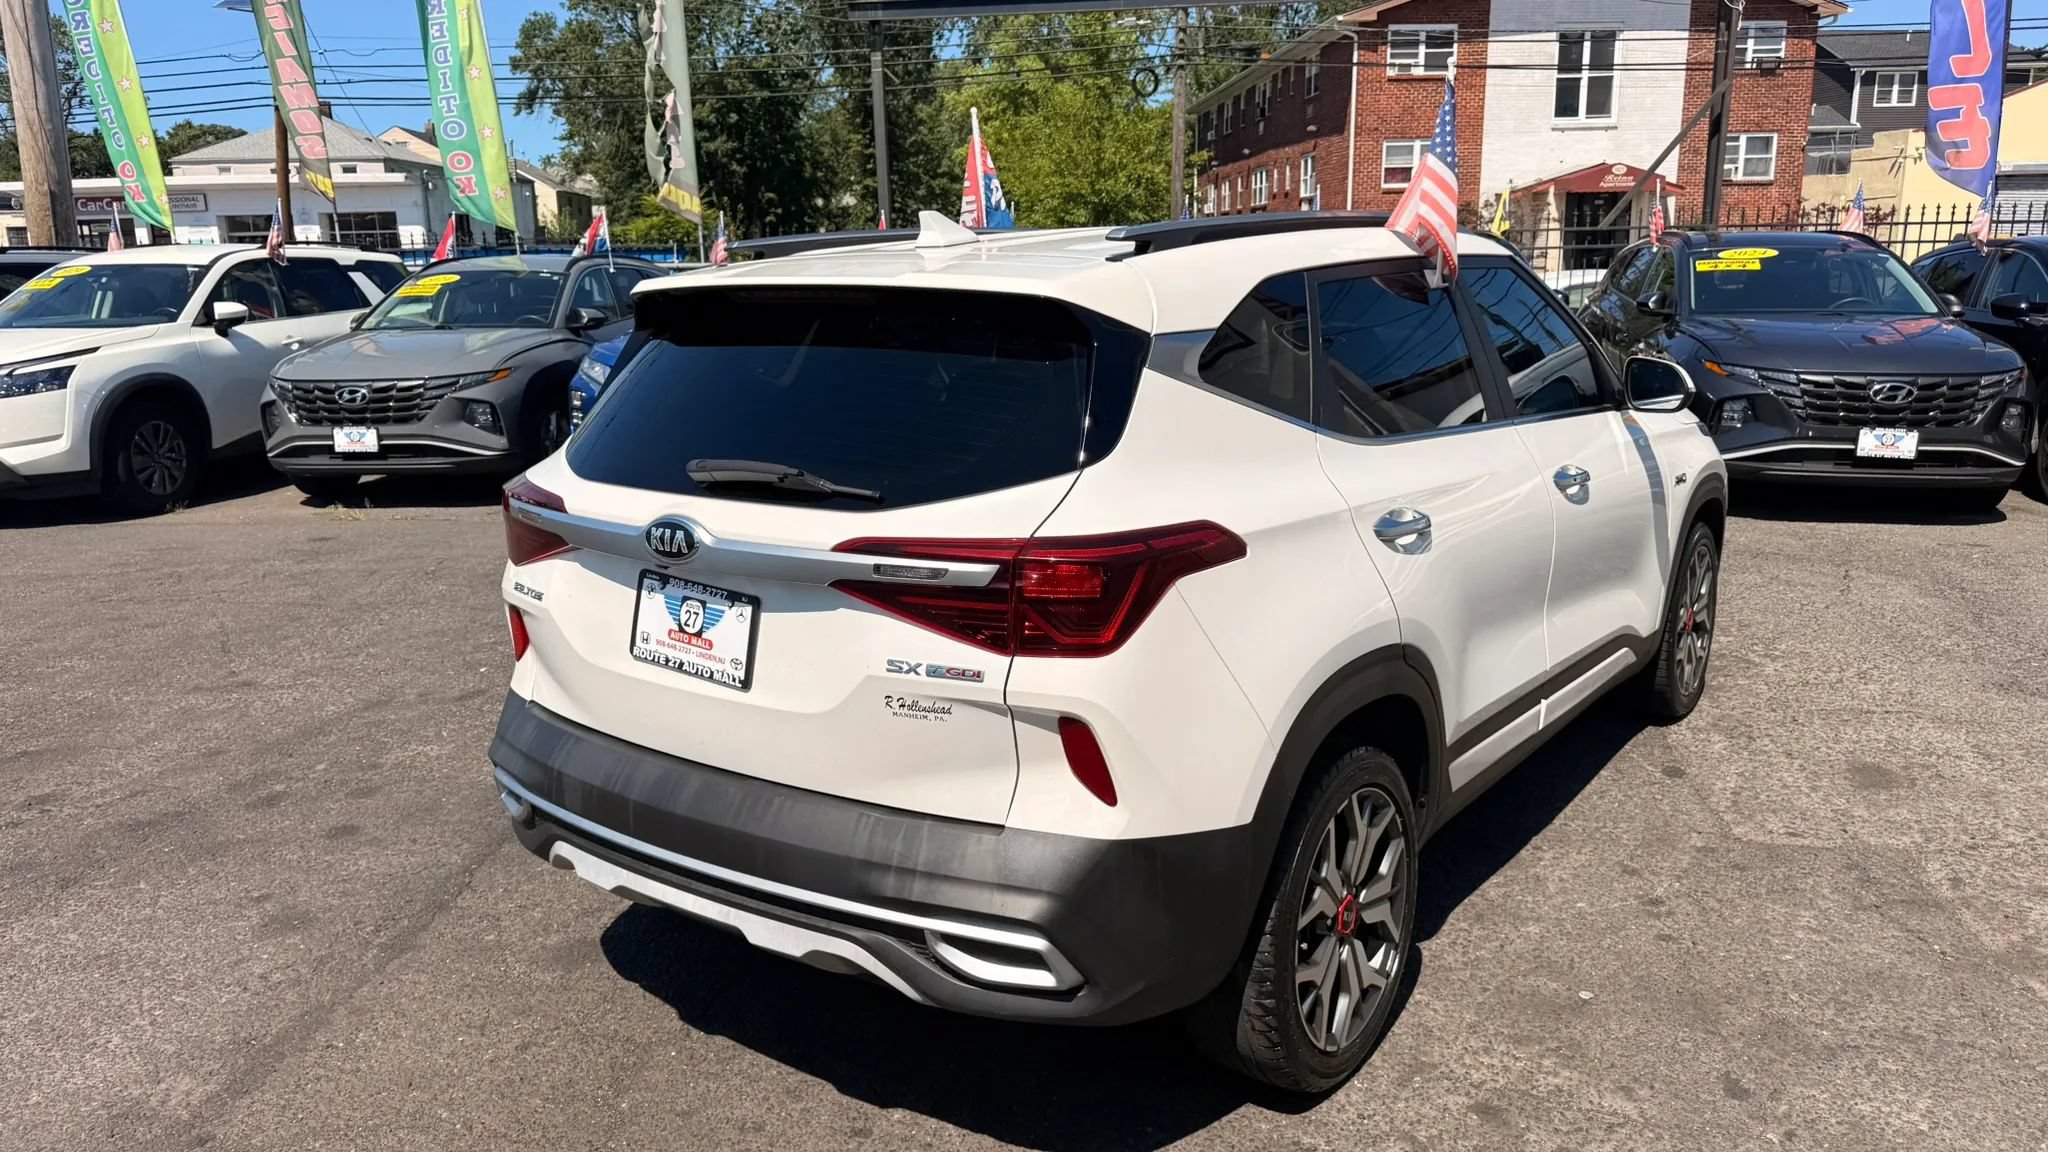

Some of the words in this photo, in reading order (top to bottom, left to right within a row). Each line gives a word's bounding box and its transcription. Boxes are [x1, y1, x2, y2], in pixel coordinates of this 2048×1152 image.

[650, 527, 689, 554] KIA
[669, 578, 728, 600] 908-648-2727
[685, 602, 701, 611] ROUTE
[683, 610, 700, 629] 27
[669, 631, 689, 643] AUTO
[690, 636, 711, 649] MALL
[633, 647, 667, 665] ROUTE
[668, 656, 683, 669] 27
[683, 661, 711, 678] AUTO
[713, 669, 742, 687] MALL
[886, 659, 923, 676] SX
[896, 697, 953, 716] Hollenshead
[892, 711, 932, 722] MANHEIM,
